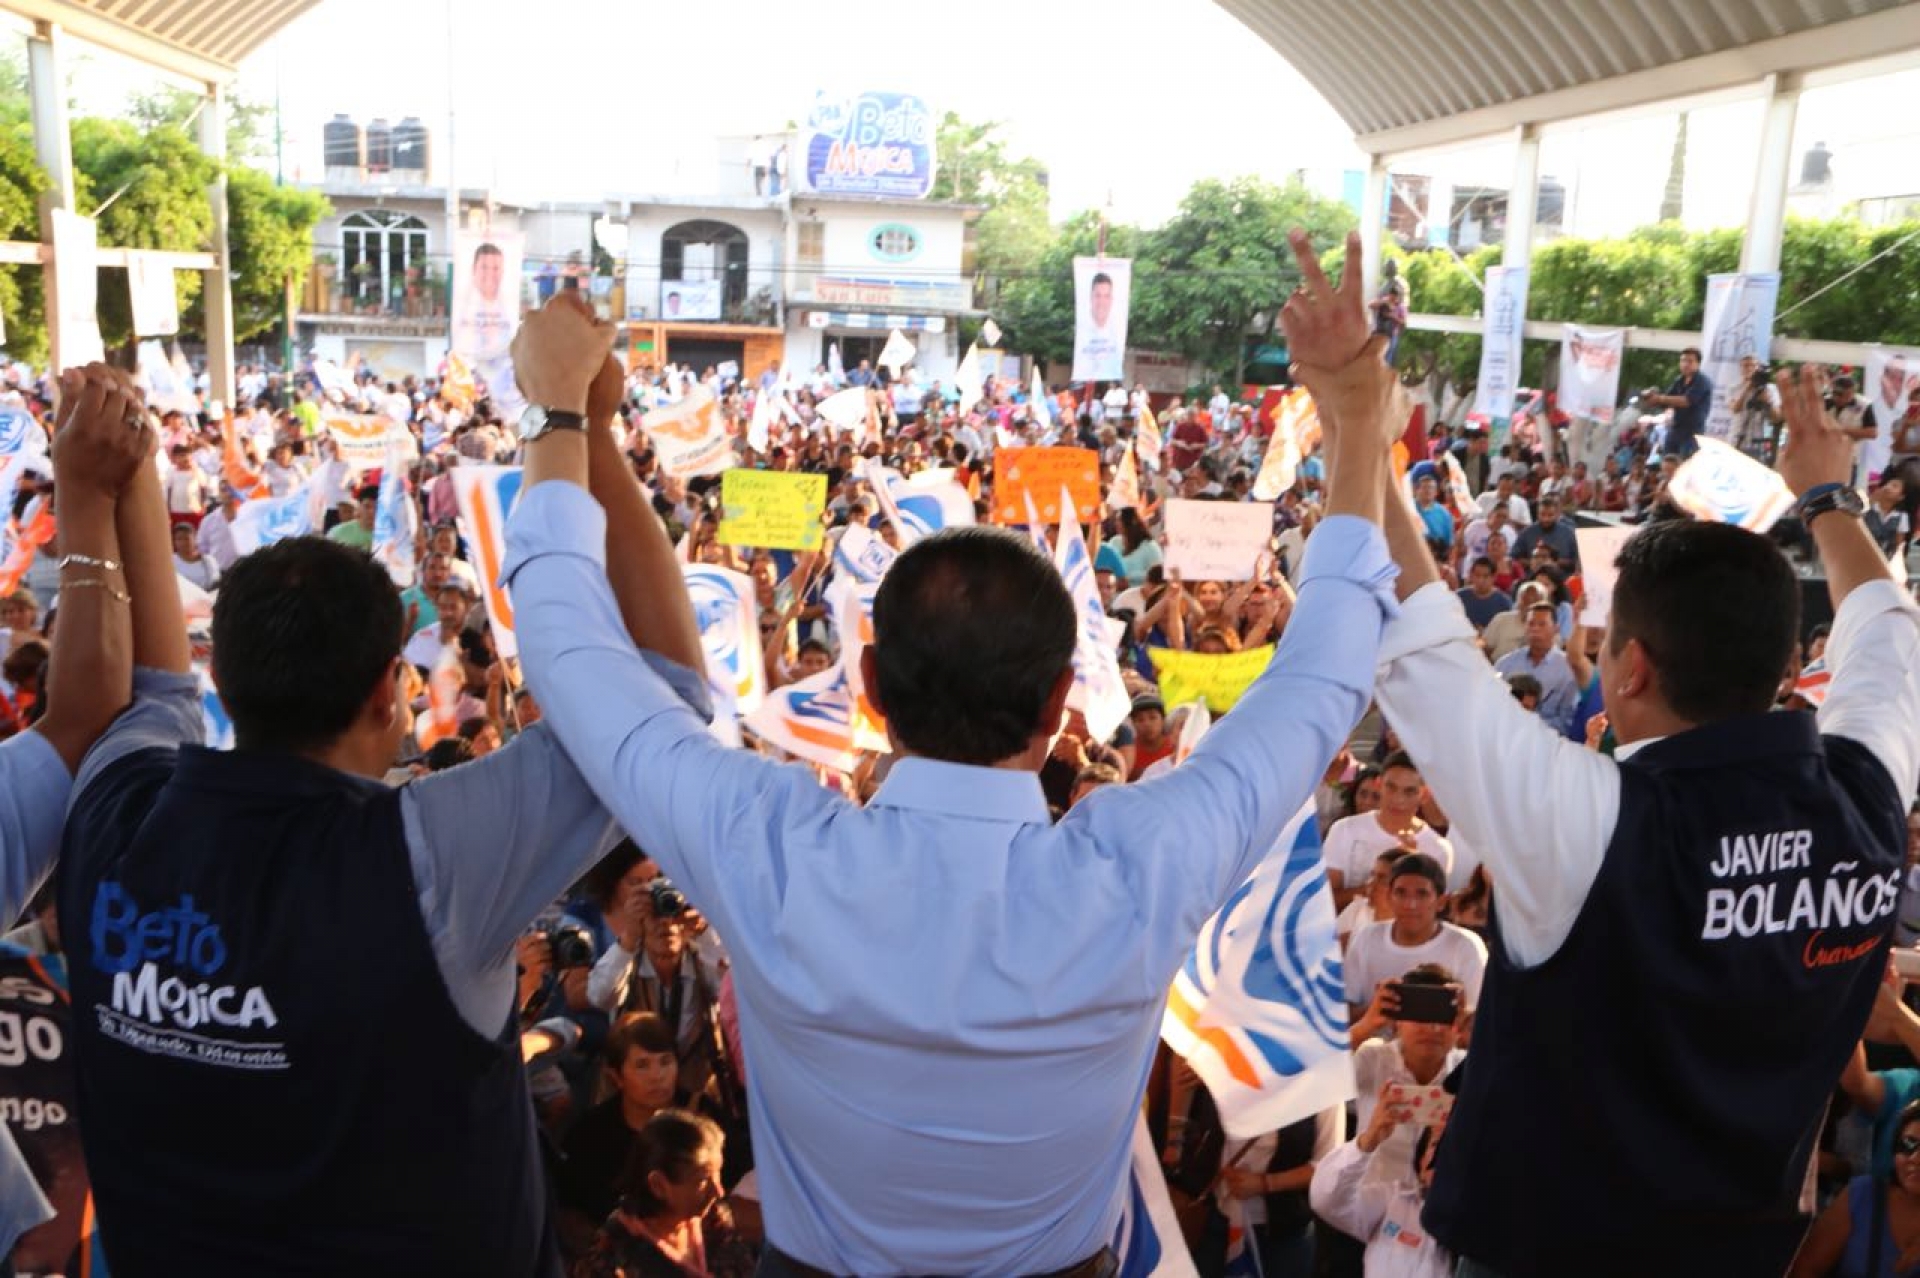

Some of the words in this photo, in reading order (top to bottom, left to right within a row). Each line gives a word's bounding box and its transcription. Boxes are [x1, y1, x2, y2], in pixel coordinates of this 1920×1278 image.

[1710, 829, 1813, 878] JAVIER
[90, 880, 228, 976] Beto
[1701, 861, 1900, 940] BOLAÑOS
